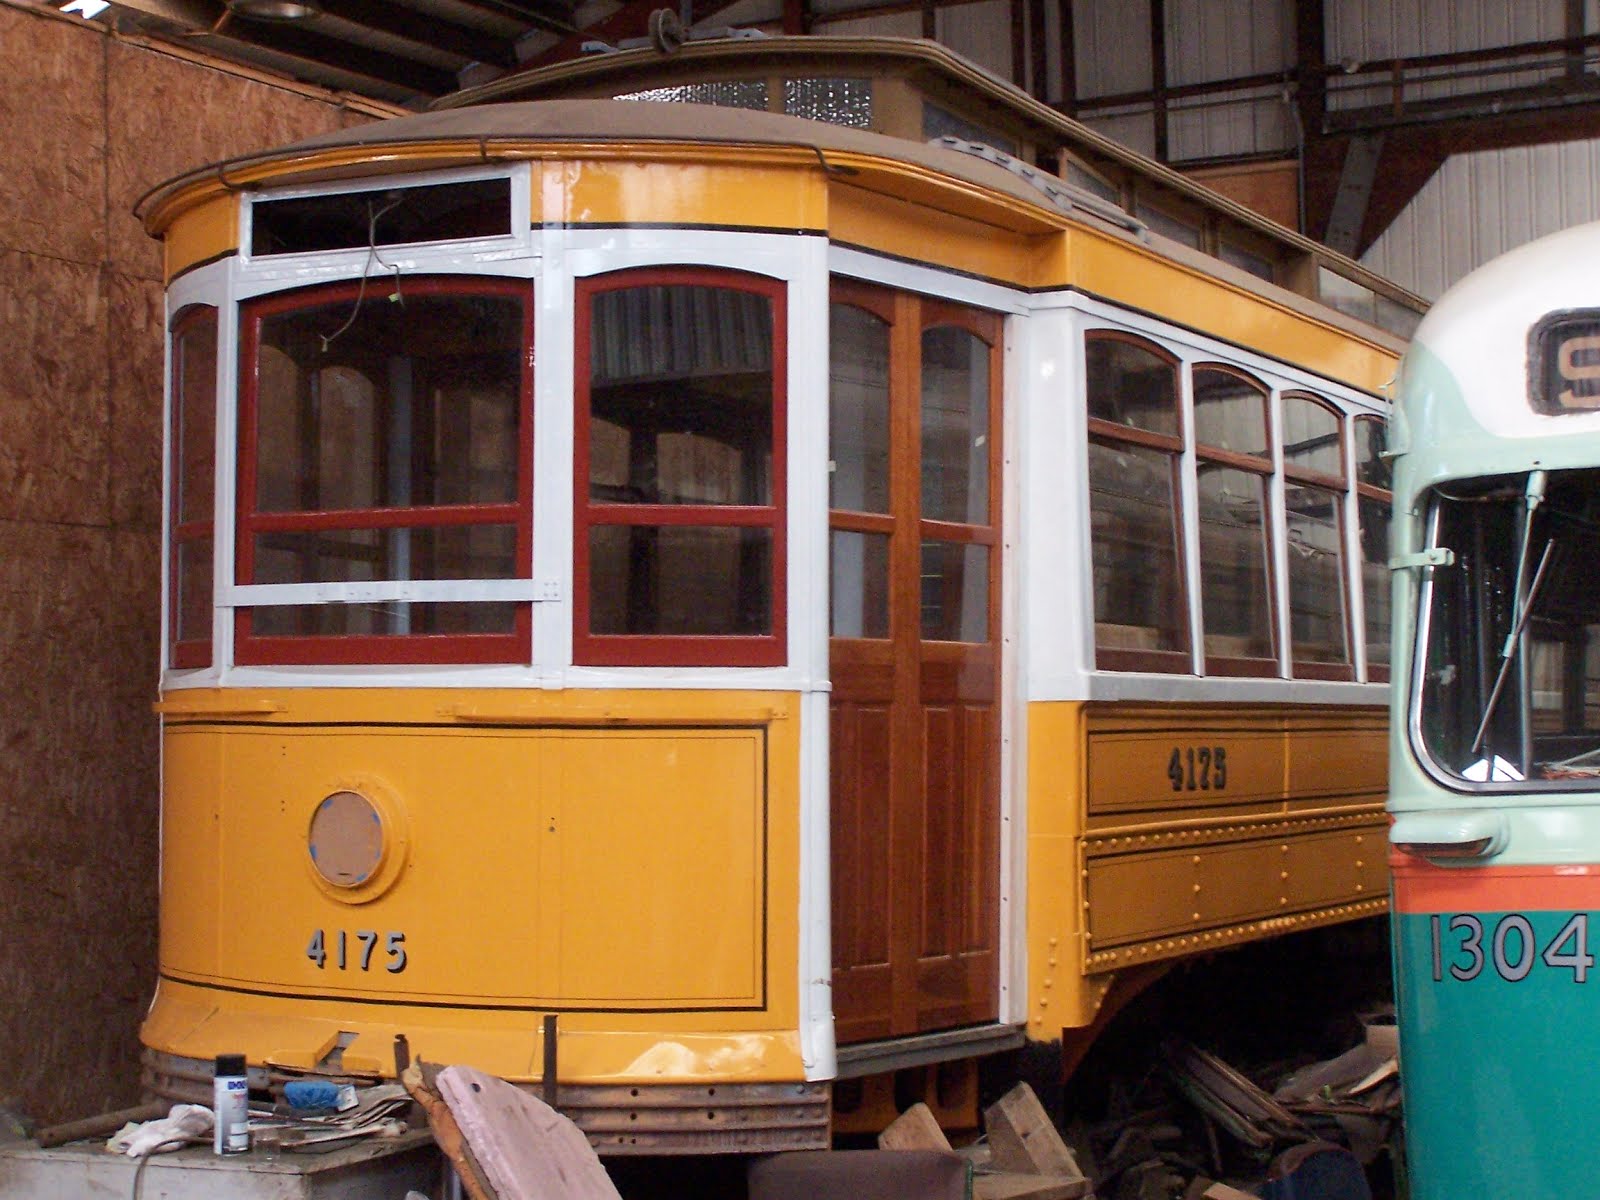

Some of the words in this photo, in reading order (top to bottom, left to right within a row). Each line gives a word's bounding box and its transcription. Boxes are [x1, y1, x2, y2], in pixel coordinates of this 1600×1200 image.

[1168, 747, 1226, 791] 4175
[307, 929, 407, 973] 4175
[1431, 913, 1594, 983] 1304
